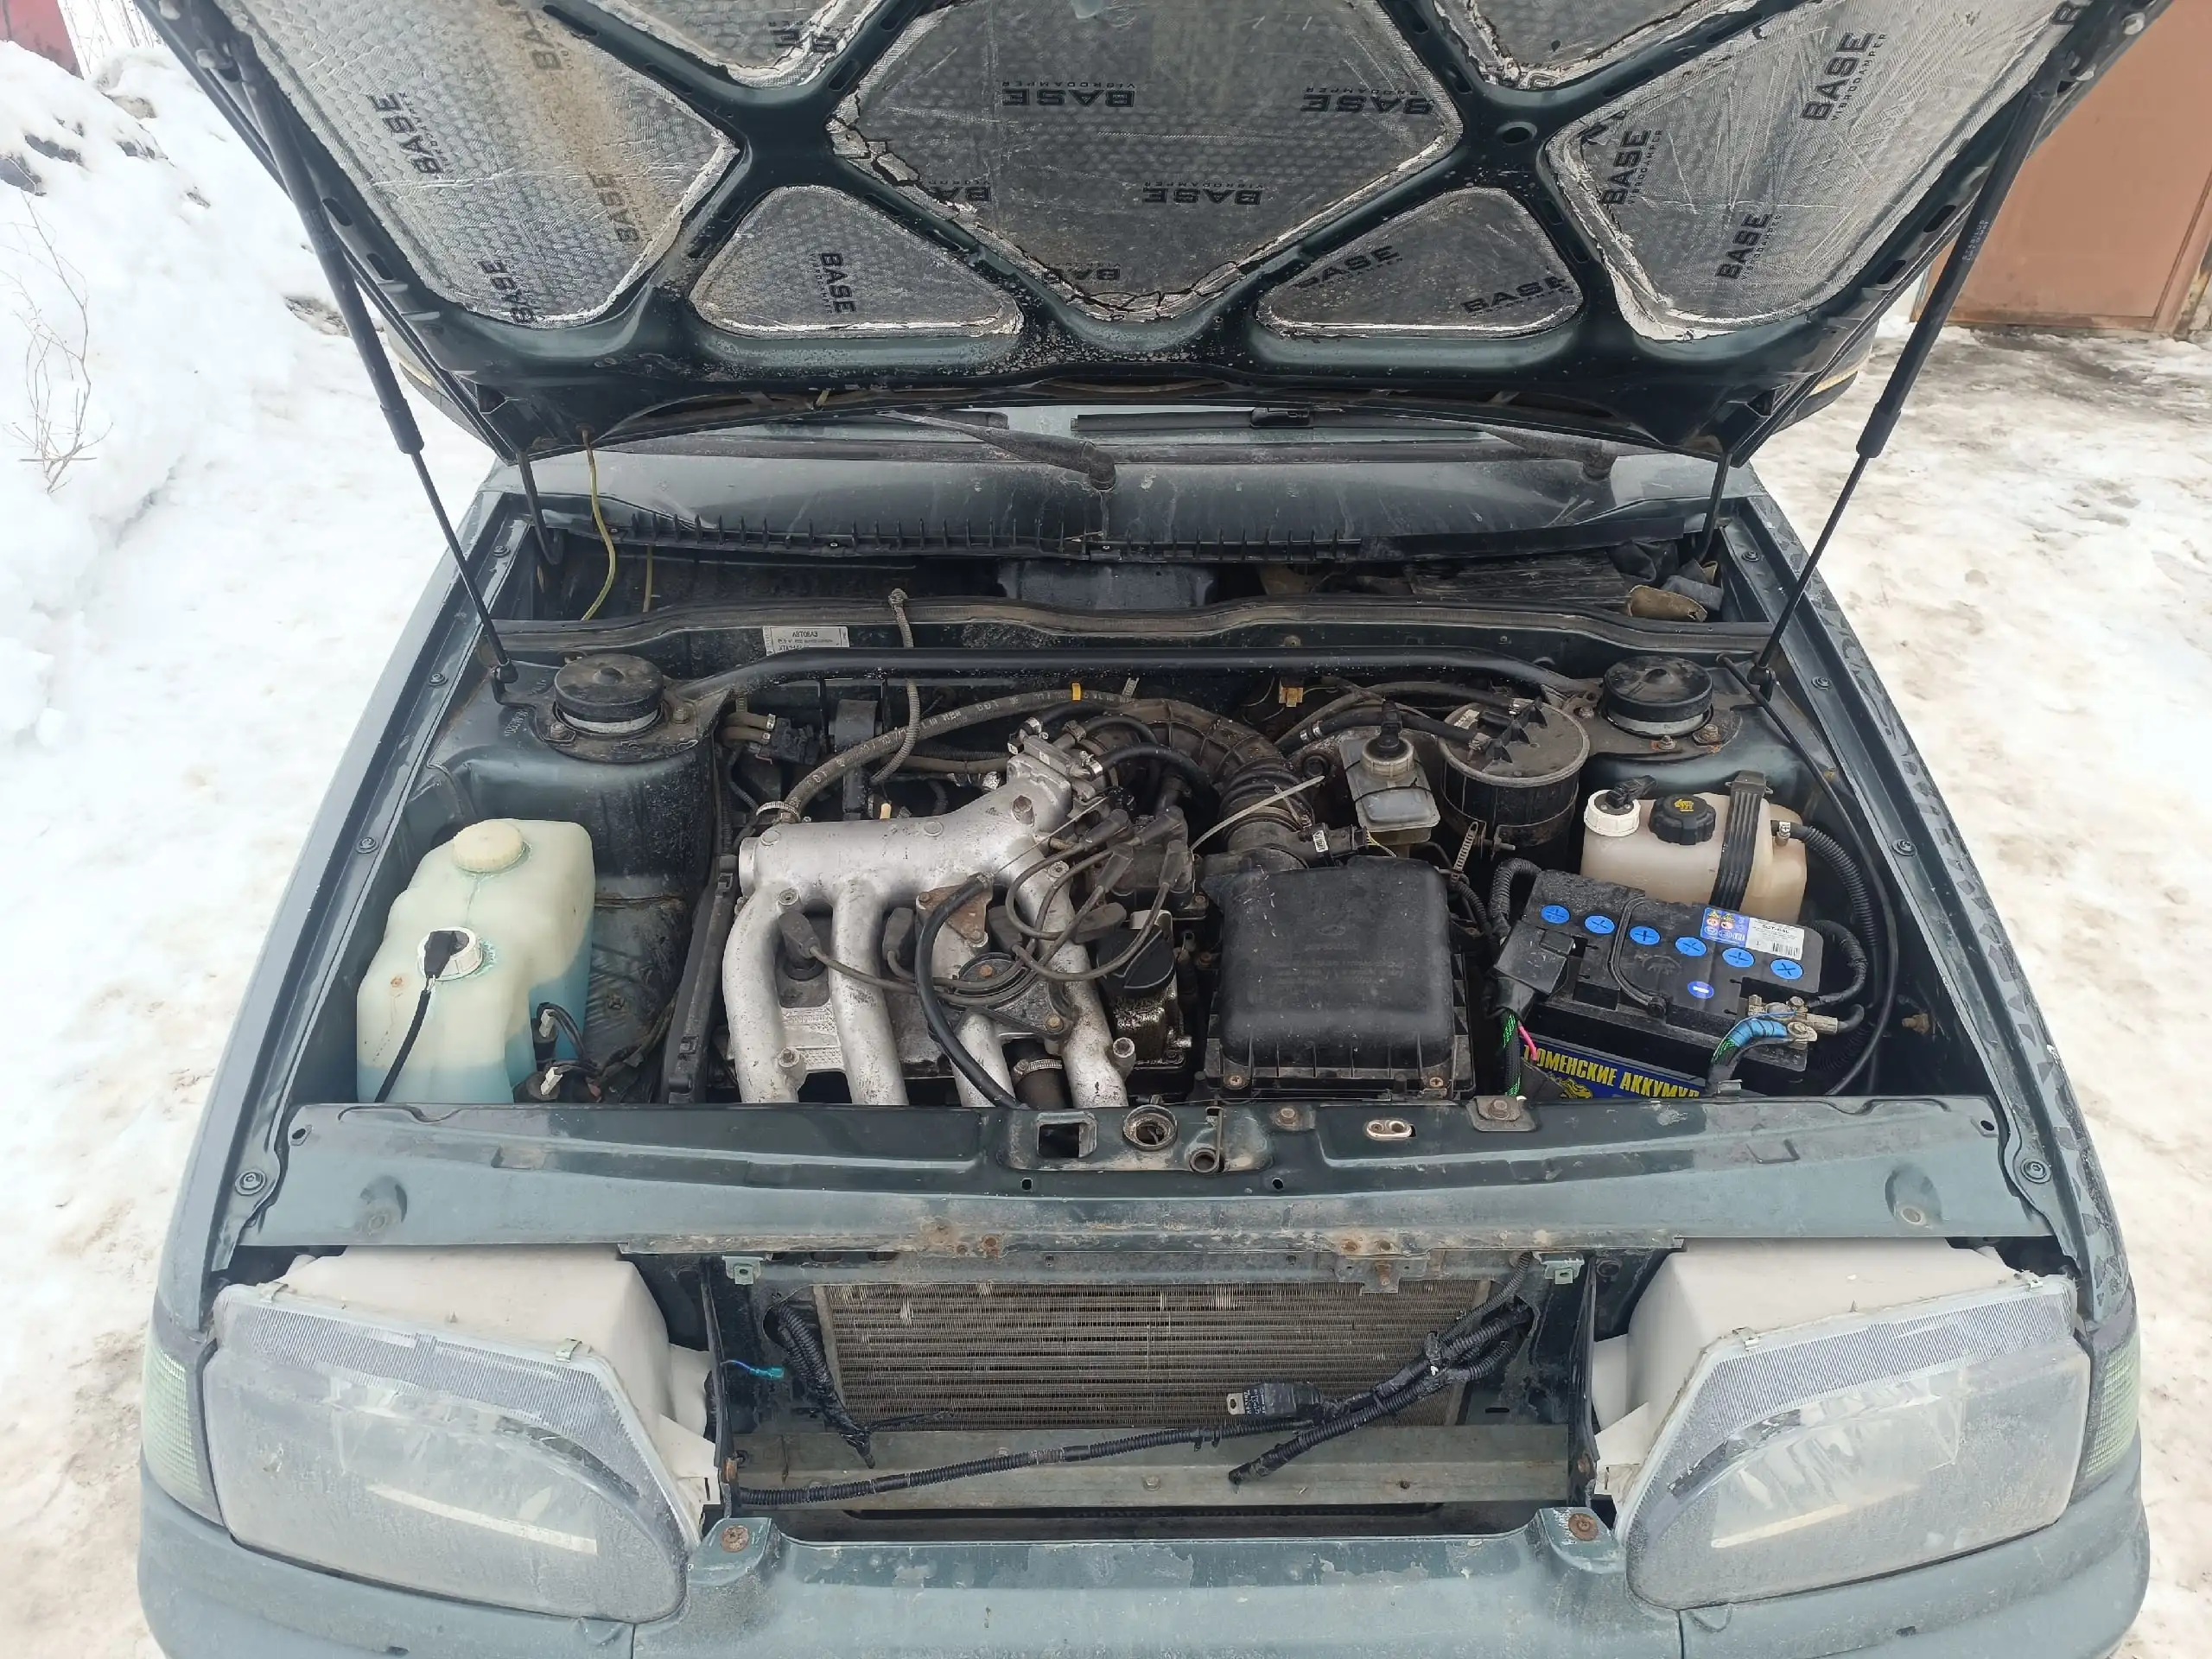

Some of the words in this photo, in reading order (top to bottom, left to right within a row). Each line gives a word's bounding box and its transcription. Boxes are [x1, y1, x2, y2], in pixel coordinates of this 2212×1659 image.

[1001, 88, 1135, 108] BASE
[1300, 94, 1435, 114] BASE
[1801, 32, 1877, 120] BASE
[1831, 34, 1887, 121] VIBRODAMPER
[365, 92, 444, 174] BASE
[1142, 188, 1262, 205] BASE
[1598, 130, 1651, 205] BASE
[588, 171, 639, 243] BASE
[1714, 213, 1773, 279] BASE
[478, 260, 537, 324] BASE
[820, 253, 857, 313] BASE
[1460, 276, 1566, 313] BASE
